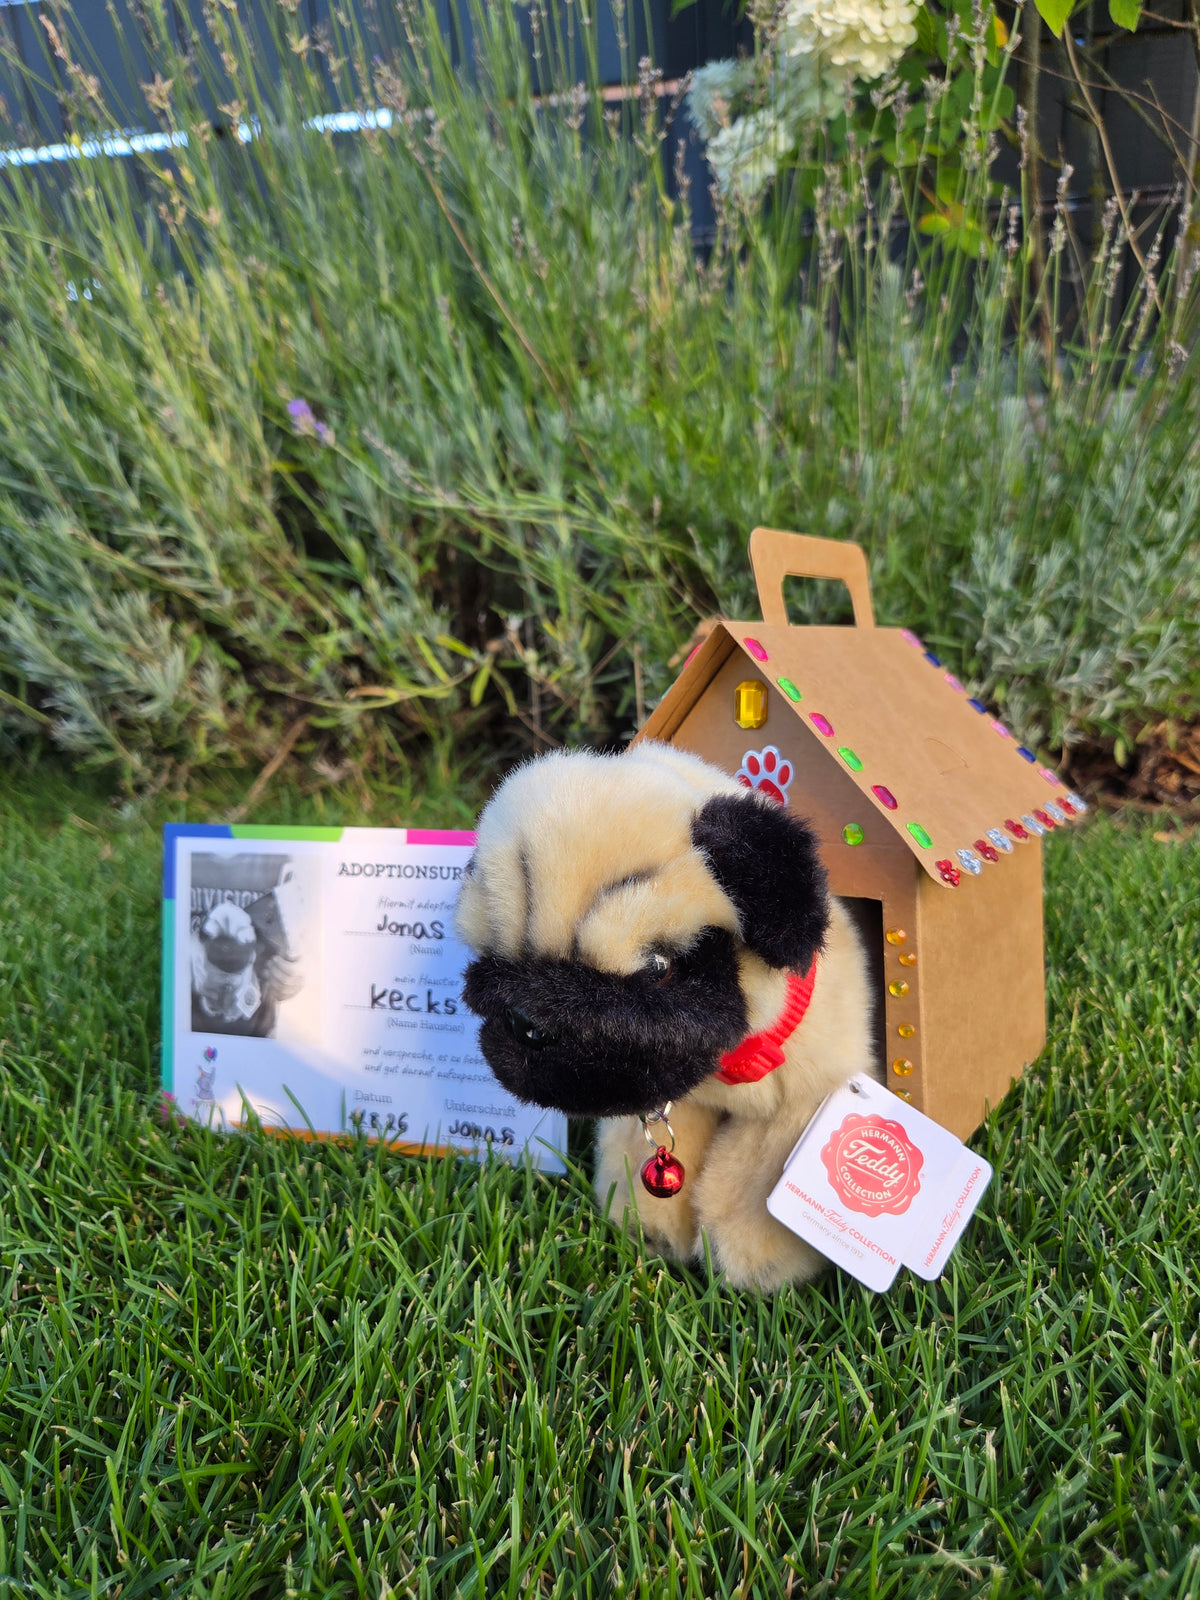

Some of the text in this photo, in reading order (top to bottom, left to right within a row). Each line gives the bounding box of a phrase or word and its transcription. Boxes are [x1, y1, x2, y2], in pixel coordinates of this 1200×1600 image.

[377, 914, 444, 940] Jonas
[354, 1089, 393, 1104] Datum
[445, 1099, 516, 1117] Unterschrift
[861, 1129, 906, 1162] HERMANN
[842, 1139, 906, 1188] Teddy
[841, 1165, 893, 1201] COLLECTION
[785, 1180, 896, 1266] HERMANN Teddy COLLECTION
[802, 1210, 832, 1237] Germany
[924, 1166, 982, 1268] HERMANN Teddy COLLECTION
